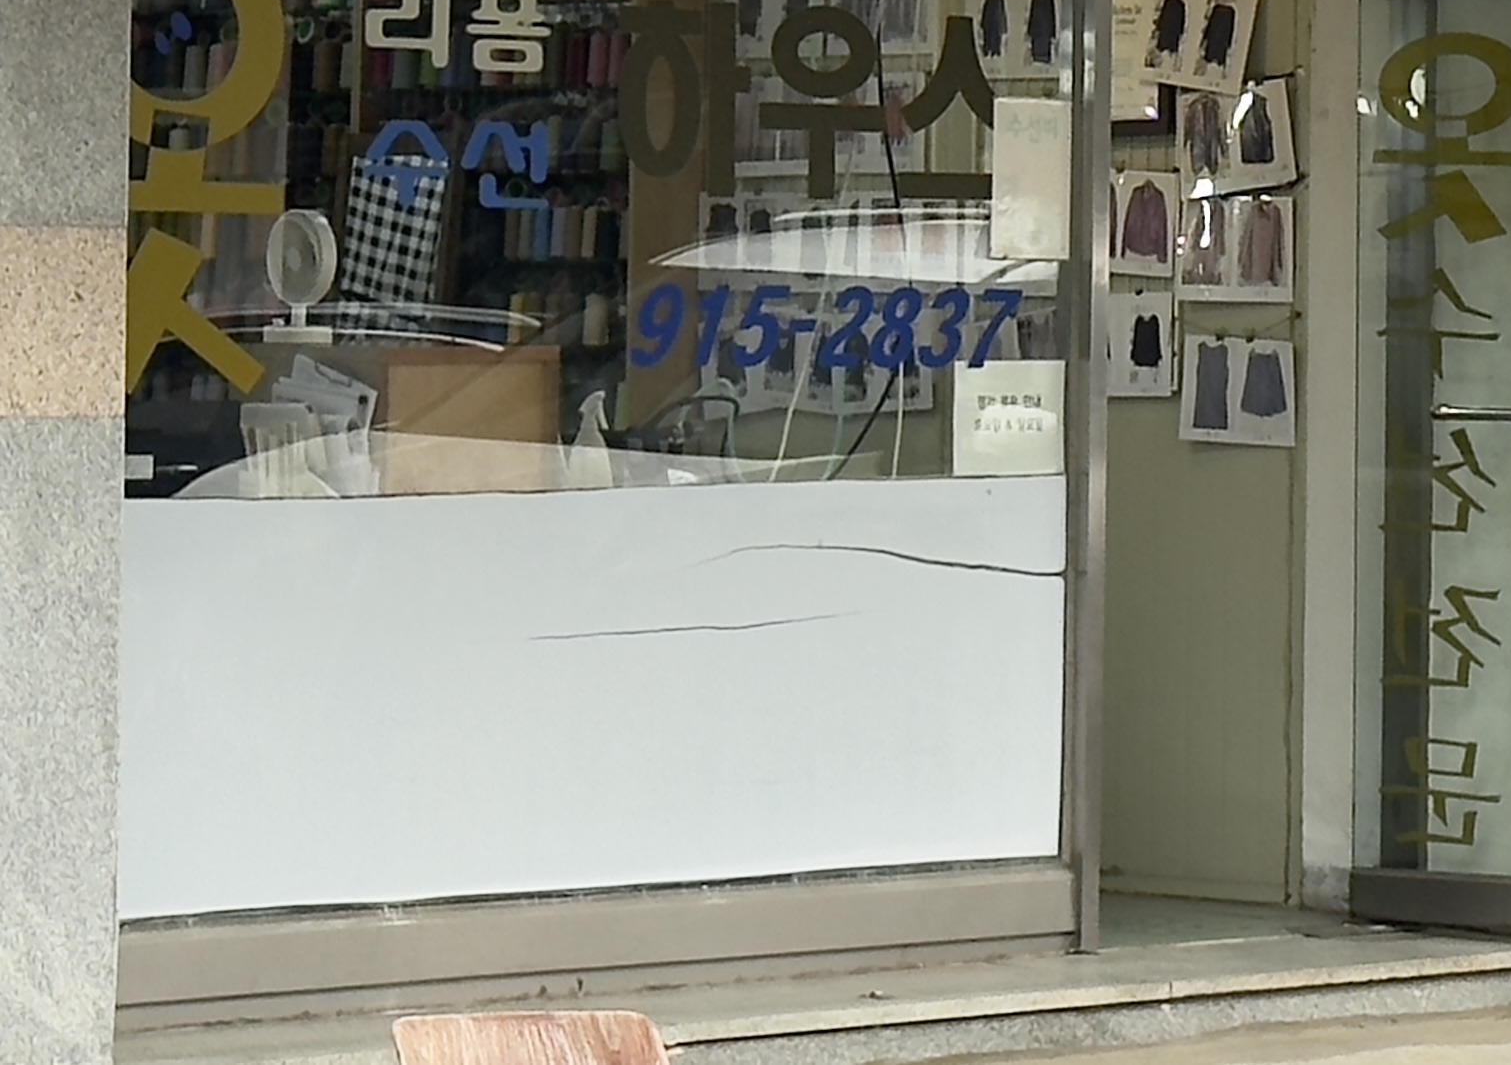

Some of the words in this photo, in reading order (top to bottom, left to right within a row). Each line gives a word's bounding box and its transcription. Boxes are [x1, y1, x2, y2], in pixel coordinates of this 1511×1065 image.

[618, 0, 994, 200] 하우스
[362, 119, 551, 211] 수선
[630, 283, 1023, 369] 915-2837
